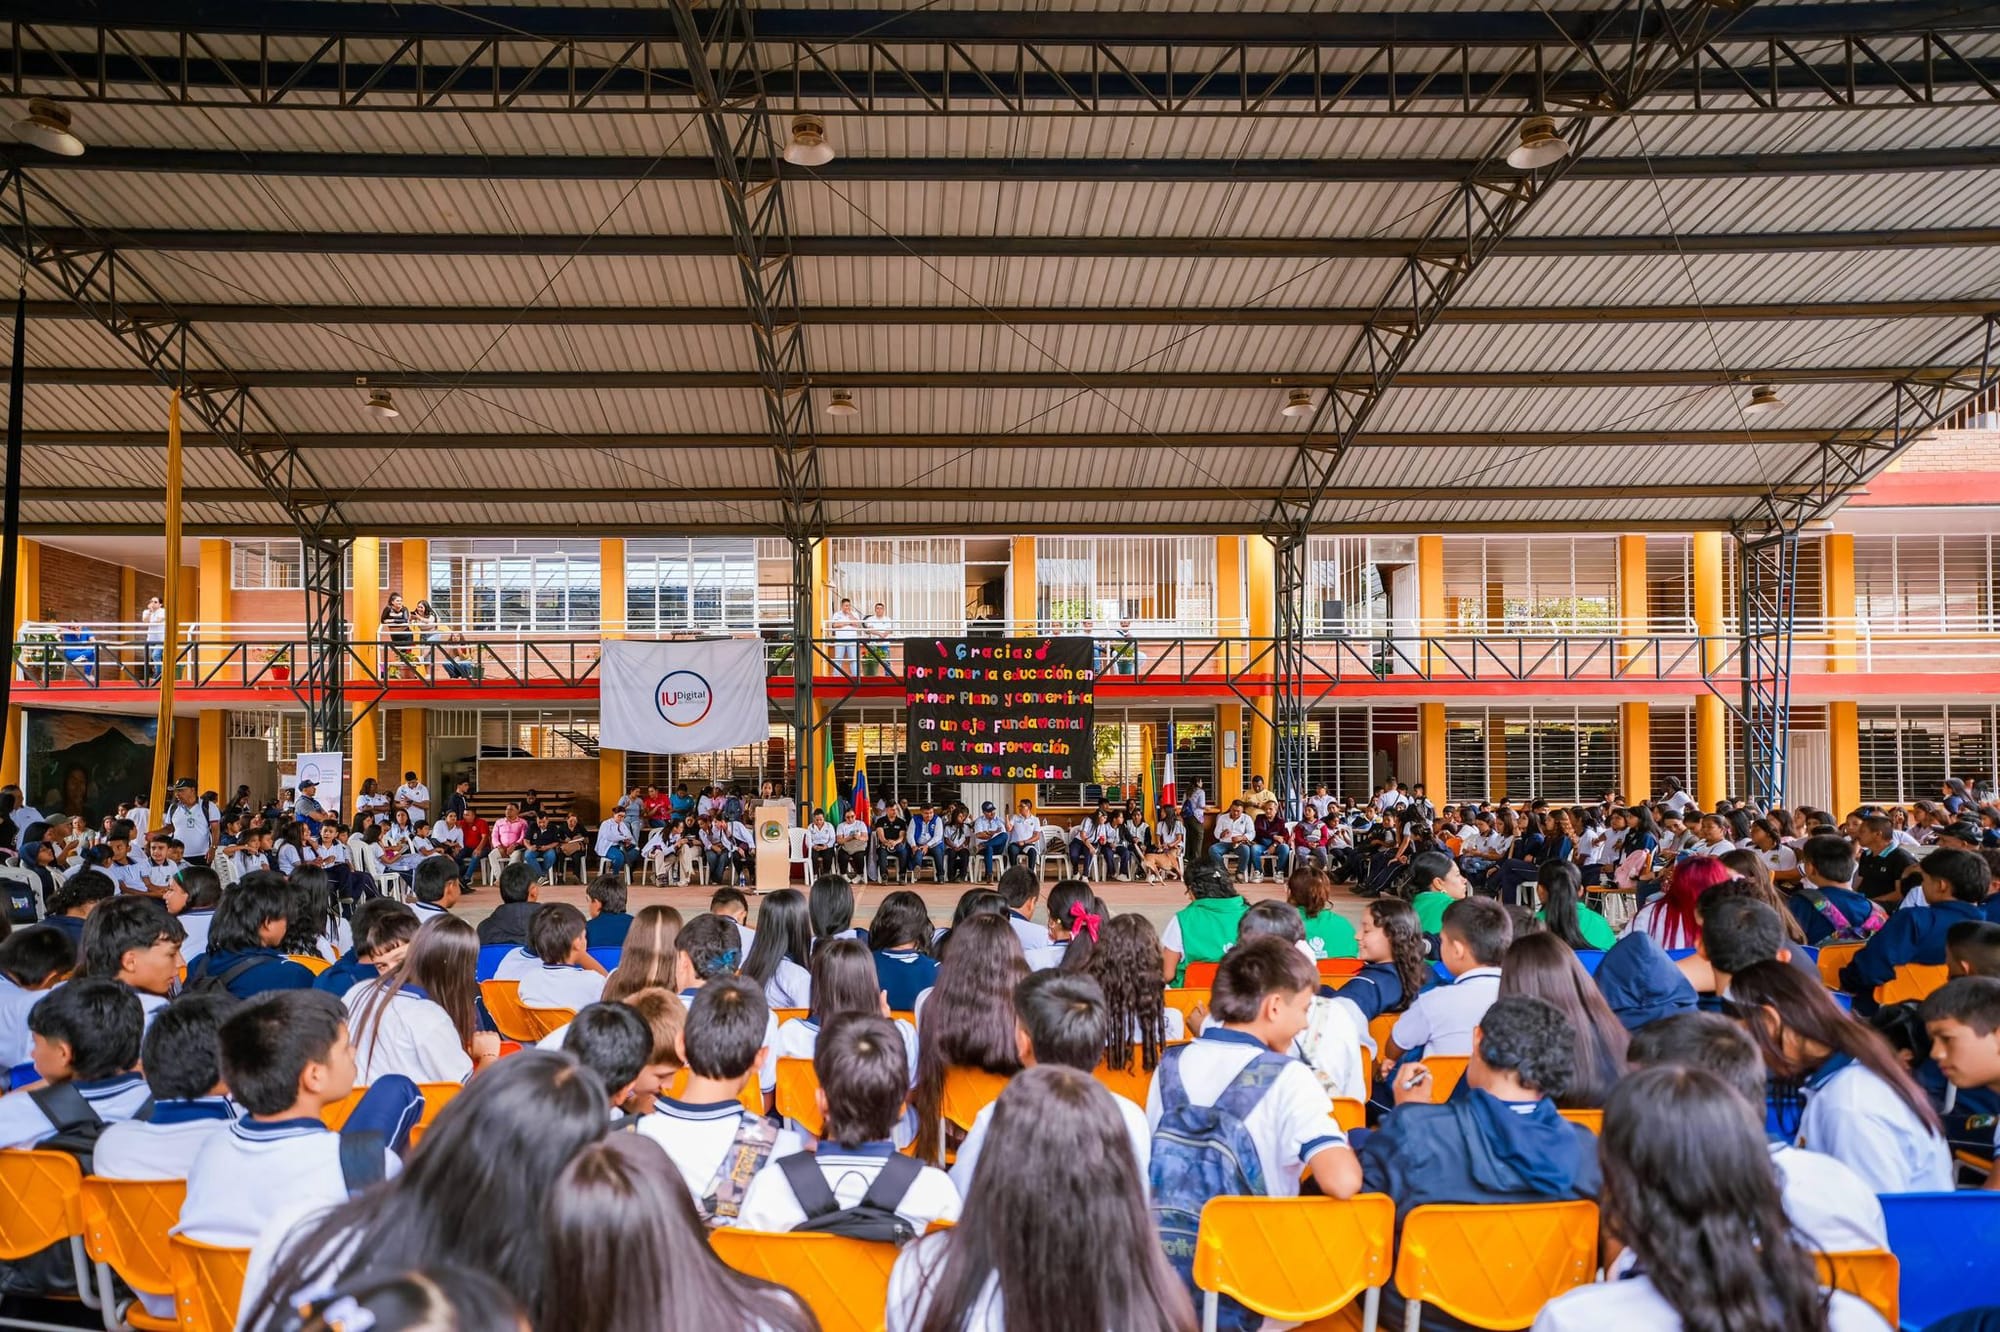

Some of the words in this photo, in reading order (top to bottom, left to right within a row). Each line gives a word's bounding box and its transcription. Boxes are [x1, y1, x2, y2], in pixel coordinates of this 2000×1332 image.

[955, 643, 1033, 660] Gracias
[985, 668, 998, 680] la
[1003, 663, 1073, 680] educación
[1076, 669, 1094, 680] en
[1004, 693, 1013, 707] y
[1015, 689, 1093, 705] convertirla
[918, 718, 936, 730] en
[940, 719, 958, 732] un
[961, 717, 986, 736] eje
[921, 740, 939, 752] en
[941, 738, 956, 752] la
[922, 762, 942, 777] de
[945, 763, 1001, 777] nuestra
[1007, 763, 1072, 779] sociedad
